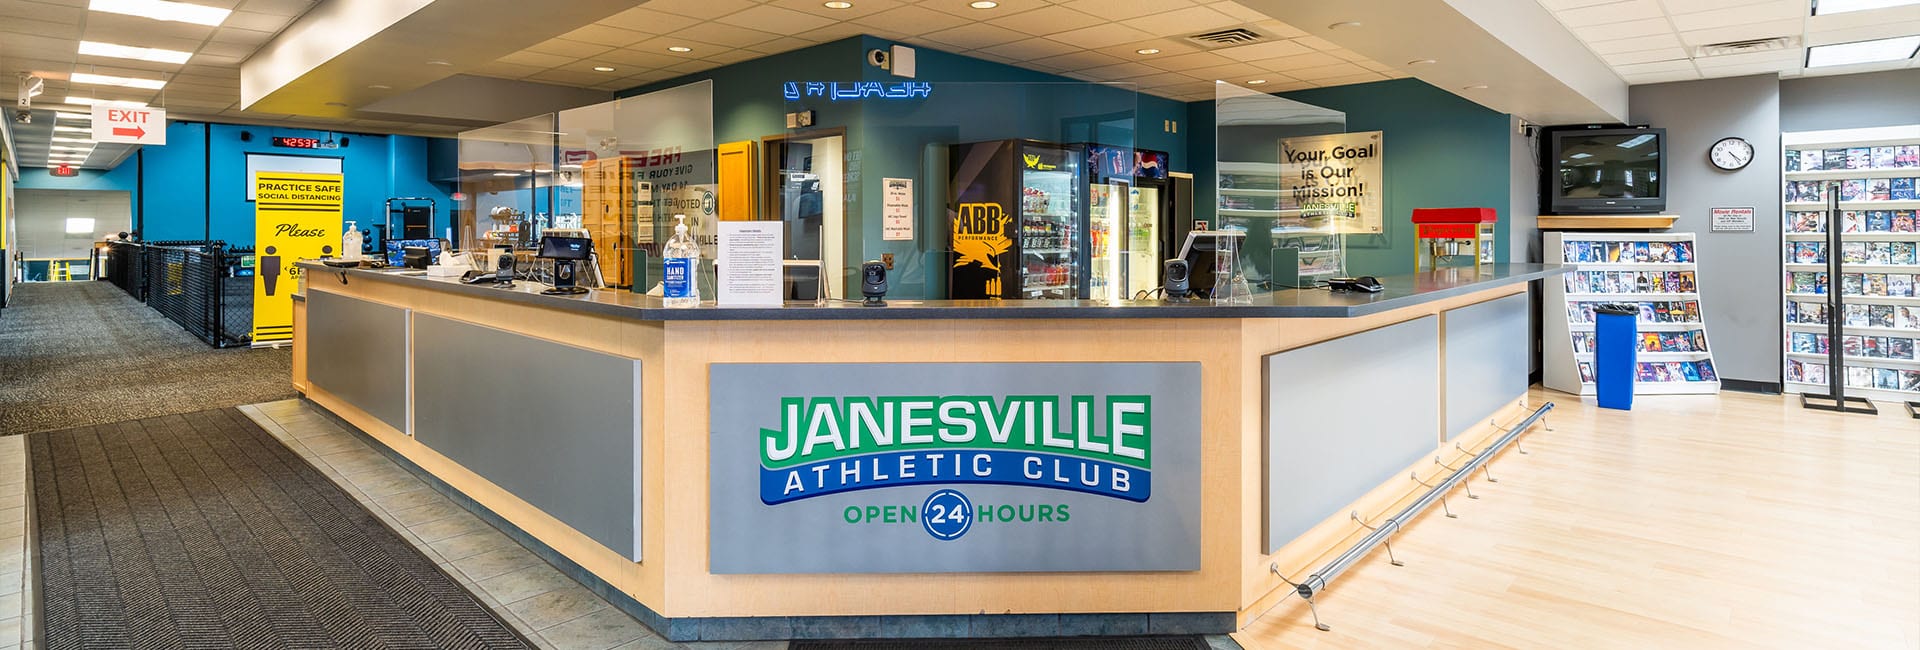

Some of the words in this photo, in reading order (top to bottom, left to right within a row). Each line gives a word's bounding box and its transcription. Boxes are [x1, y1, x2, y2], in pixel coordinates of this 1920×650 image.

[108, 109, 150, 123] EXIT
[1285, 149, 1326, 163] Your
[1332, 143, 1373, 160] Goal
[57, 167, 71, 175] EXIT
[1301, 167, 1314, 180] is
[1320, 166, 1354, 179] Our
[258, 183, 312, 191] PRACTICE
[314, 185, 341, 193] SAFE
[1292, 183, 1363, 198] Mission!
[676, 199, 701, 209] VOTED
[691, 217, 699, 226] IN
[958, 204, 1000, 235] ABB
[275, 223, 325, 237] Please
[666, 267, 685, 275] HAND
[767, 399, 1145, 461] JANESVILLE
[783, 453, 993, 496] ATHLETIC
[1023, 456, 1131, 493] CLUB
[844, 505, 917, 524] OPEN
[931, 504, 965, 524] 24
[978, 504, 1070, 523] HOURS
